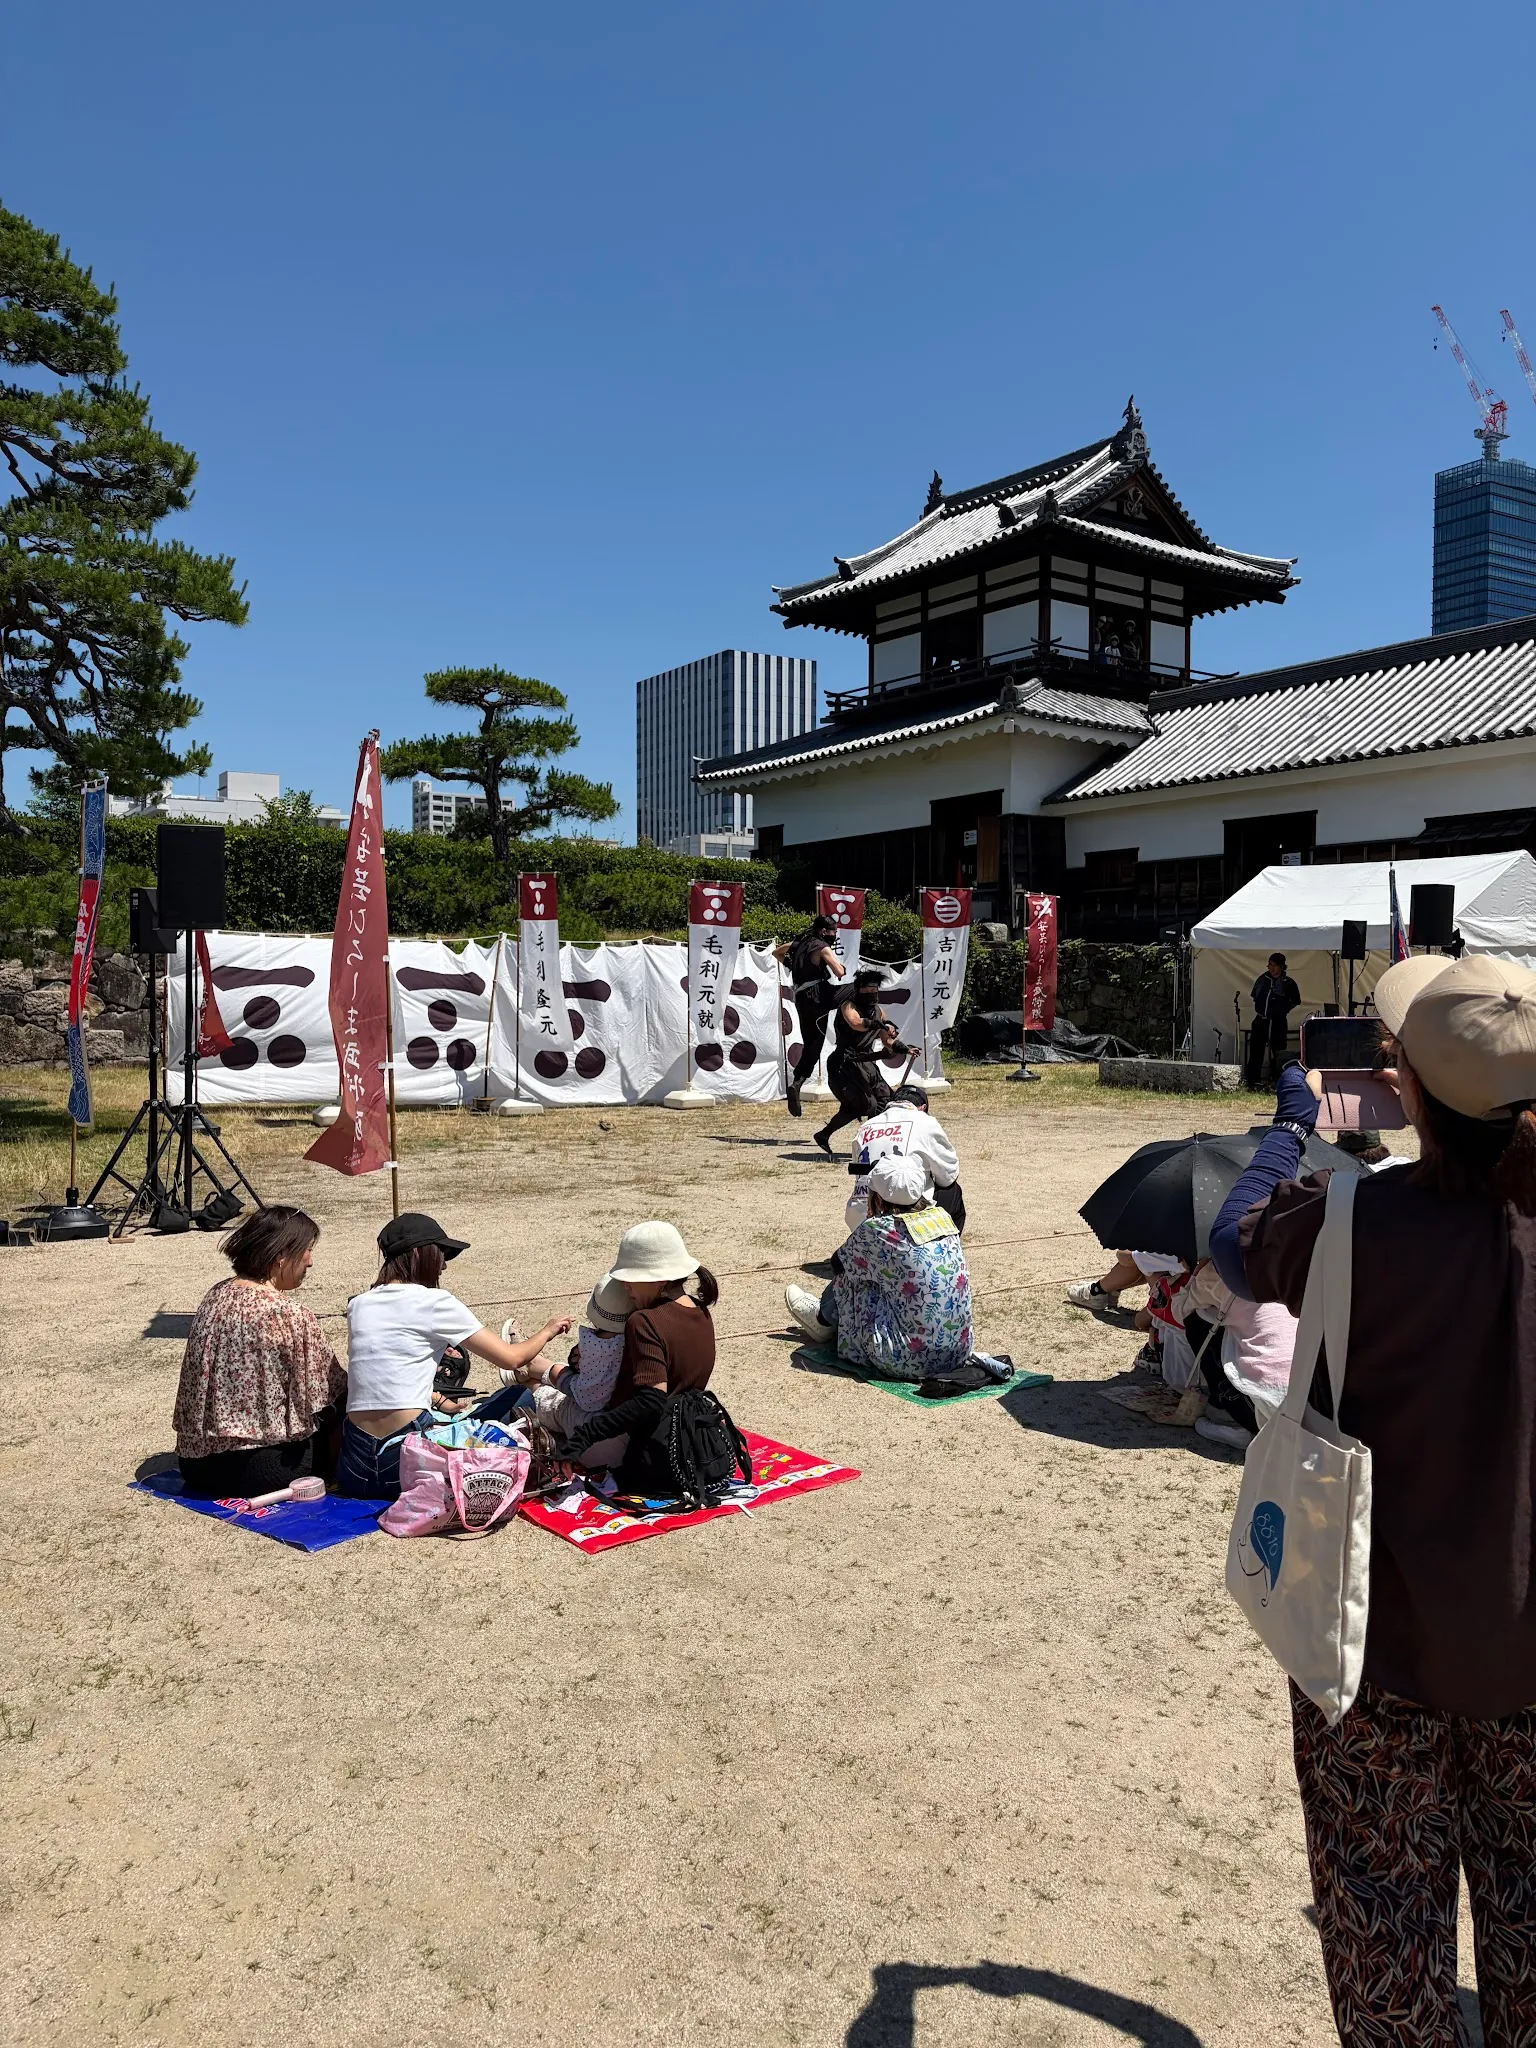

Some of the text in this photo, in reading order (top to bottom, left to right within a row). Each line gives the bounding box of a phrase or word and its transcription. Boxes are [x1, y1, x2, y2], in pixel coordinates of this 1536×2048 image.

[697, 935, 722, 1029] 毛利元就
[861, 1125, 902, 1145] KEBOZ
[469, 1479, 510, 1493] ATTACK
